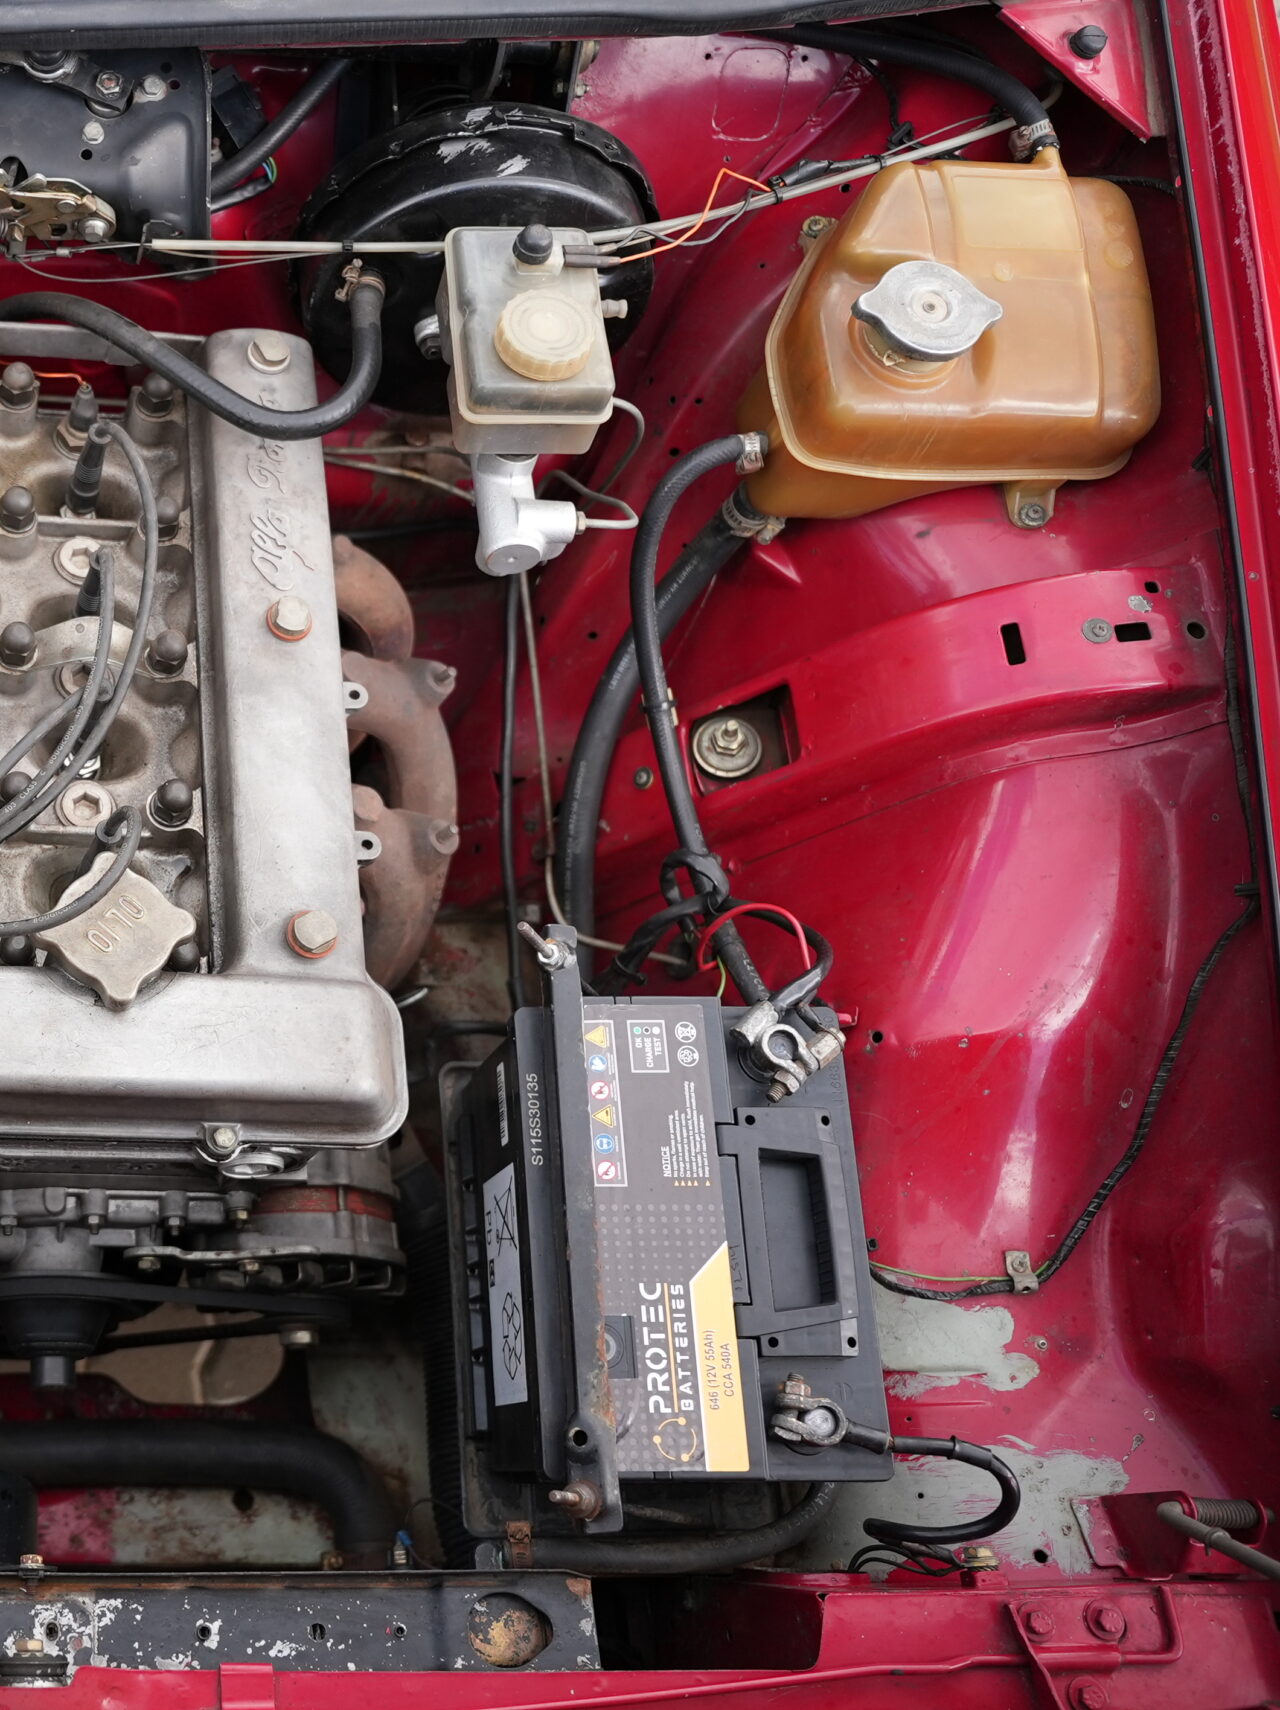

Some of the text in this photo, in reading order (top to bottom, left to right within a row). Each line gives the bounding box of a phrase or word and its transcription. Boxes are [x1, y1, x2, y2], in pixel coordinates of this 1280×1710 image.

[249, 509, 314, 591] Alfa
[4, 802, 17, 813] 403
[20, 781, 38, 799] CLASS
[49, 725, 74, 765] BOUGICORD
[87, 896, 144, 952] OLIO
[634, 1037, 642, 1048] OK
[644, 1037, 654, 1067] CHARGE
[653, 1037, 662, 1056] TEST
[526, 1073, 544, 1166] S115S30135
[661, 1146, 672, 1177] NOTICE
[486, 1211, 492, 1245] Pb
[639, 1282, 672, 1414] PROTEC
[670, 1284, 694, 1411] BATTERIES
[703, 1330, 720, 1410] 646 (12V 55Ah)
[720, 1343, 735, 1397] CCA 540A
